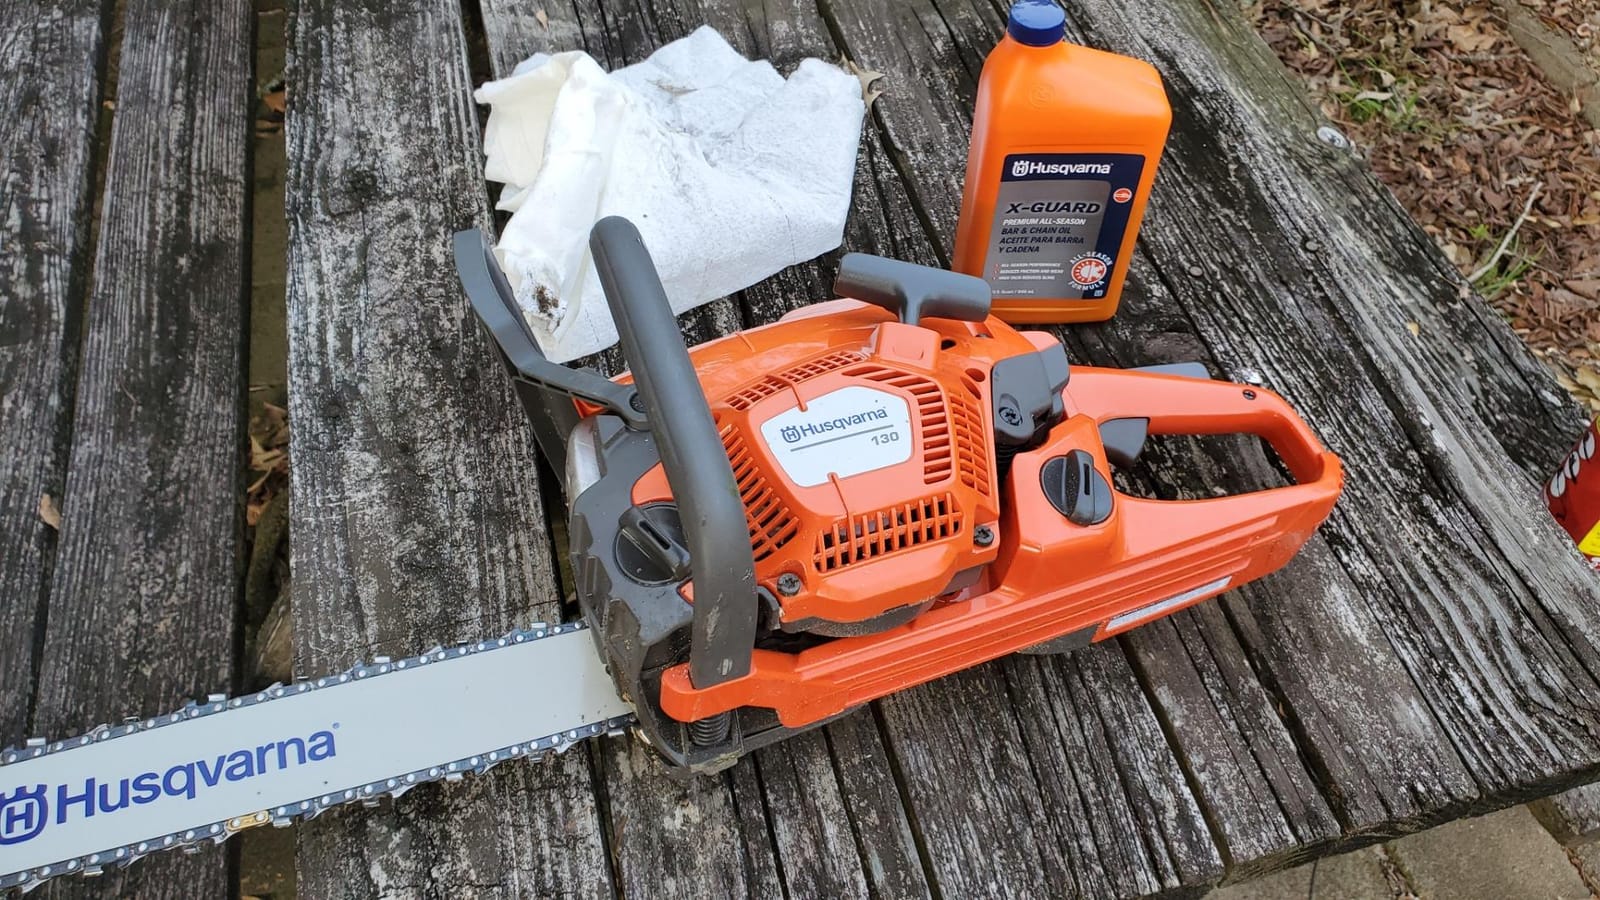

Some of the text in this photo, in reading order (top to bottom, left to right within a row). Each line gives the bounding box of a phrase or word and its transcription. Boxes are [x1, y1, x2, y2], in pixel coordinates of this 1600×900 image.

[1029, 162, 1111, 176] Husqvarna
[1006, 202, 1101, 214] X-GUARD
[1002, 218, 1087, 227] PREMIUM ALL-SEASON
[1001, 227, 1019, 235] BAR
[1020, 227, 1028, 235] &
[1000, 236, 1085, 245] ACEITE PARA BARRA
[998, 246, 1040, 254] Y CADENA
[1068, 280, 1105, 291] FORMULA
[800, 408, 888, 438] Husqvarna
[871, 431, 900, 446] 130
[56, 730, 337, 824] Husqvarna
